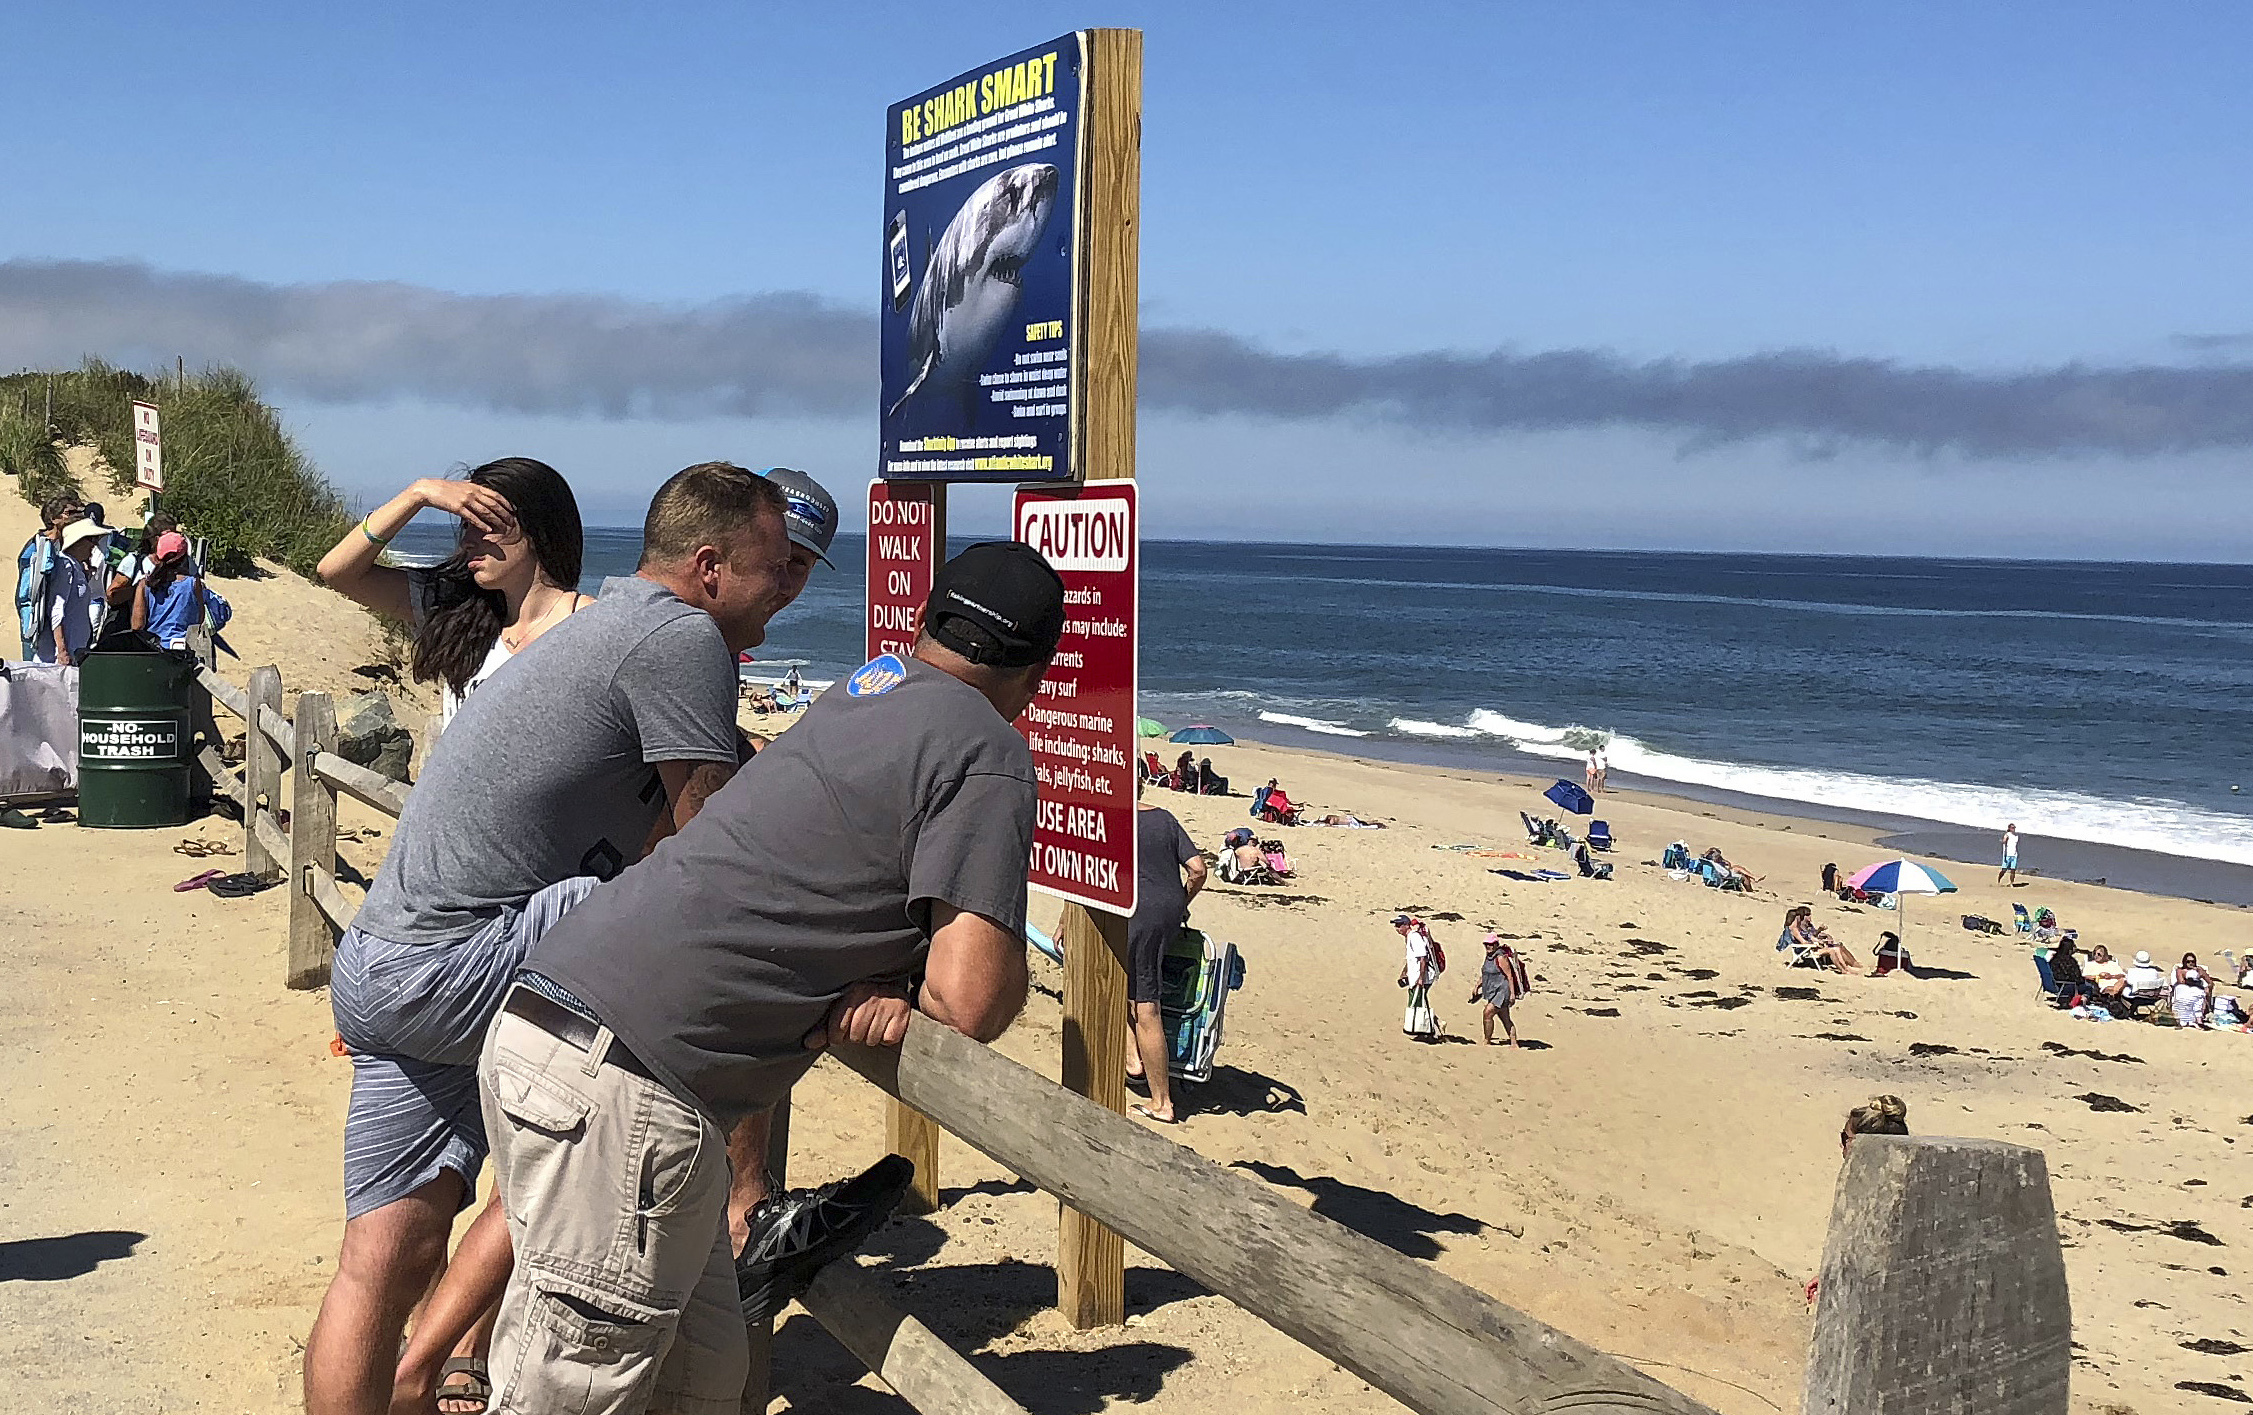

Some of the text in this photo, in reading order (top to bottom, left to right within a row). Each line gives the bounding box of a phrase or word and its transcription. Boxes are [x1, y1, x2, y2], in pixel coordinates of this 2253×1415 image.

[902, 105, 921, 145] BE
[924, 80, 978, 136] SHARK
[981, 52, 1057, 114] SMART
[1026, 320, 1063, 342] SAFETY TIPS
[871, 501, 926, 525] DO NOT
[878, 535, 921, 561] WALK
[1025, 512, 1124, 559] CAUTION
[888, 570, 911, 596] ON
[1063, 585, 1102, 605] azards in
[873, 604, 915, 632] DUNE
[1072, 620, 1091, 640] may
[1092, 616, 1128, 637] include:
[1050, 651, 1083, 668] rrents
[1038, 677, 1077, 701] avy surf
[1028, 702, 1113, 734] Dangerous marine
[83, 732, 175, 745] HOUSEHOLD
[97, 745, 154, 756] TRASH
[1029, 731, 1126, 770] life including: sharks,
[1034, 762, 1113, 796] als, jellyfish, etc.
[1036, 799, 1107, 843] USE AREA
[1045, 845, 1082, 883] OWN
[1085, 854, 1119, 893] RISK
